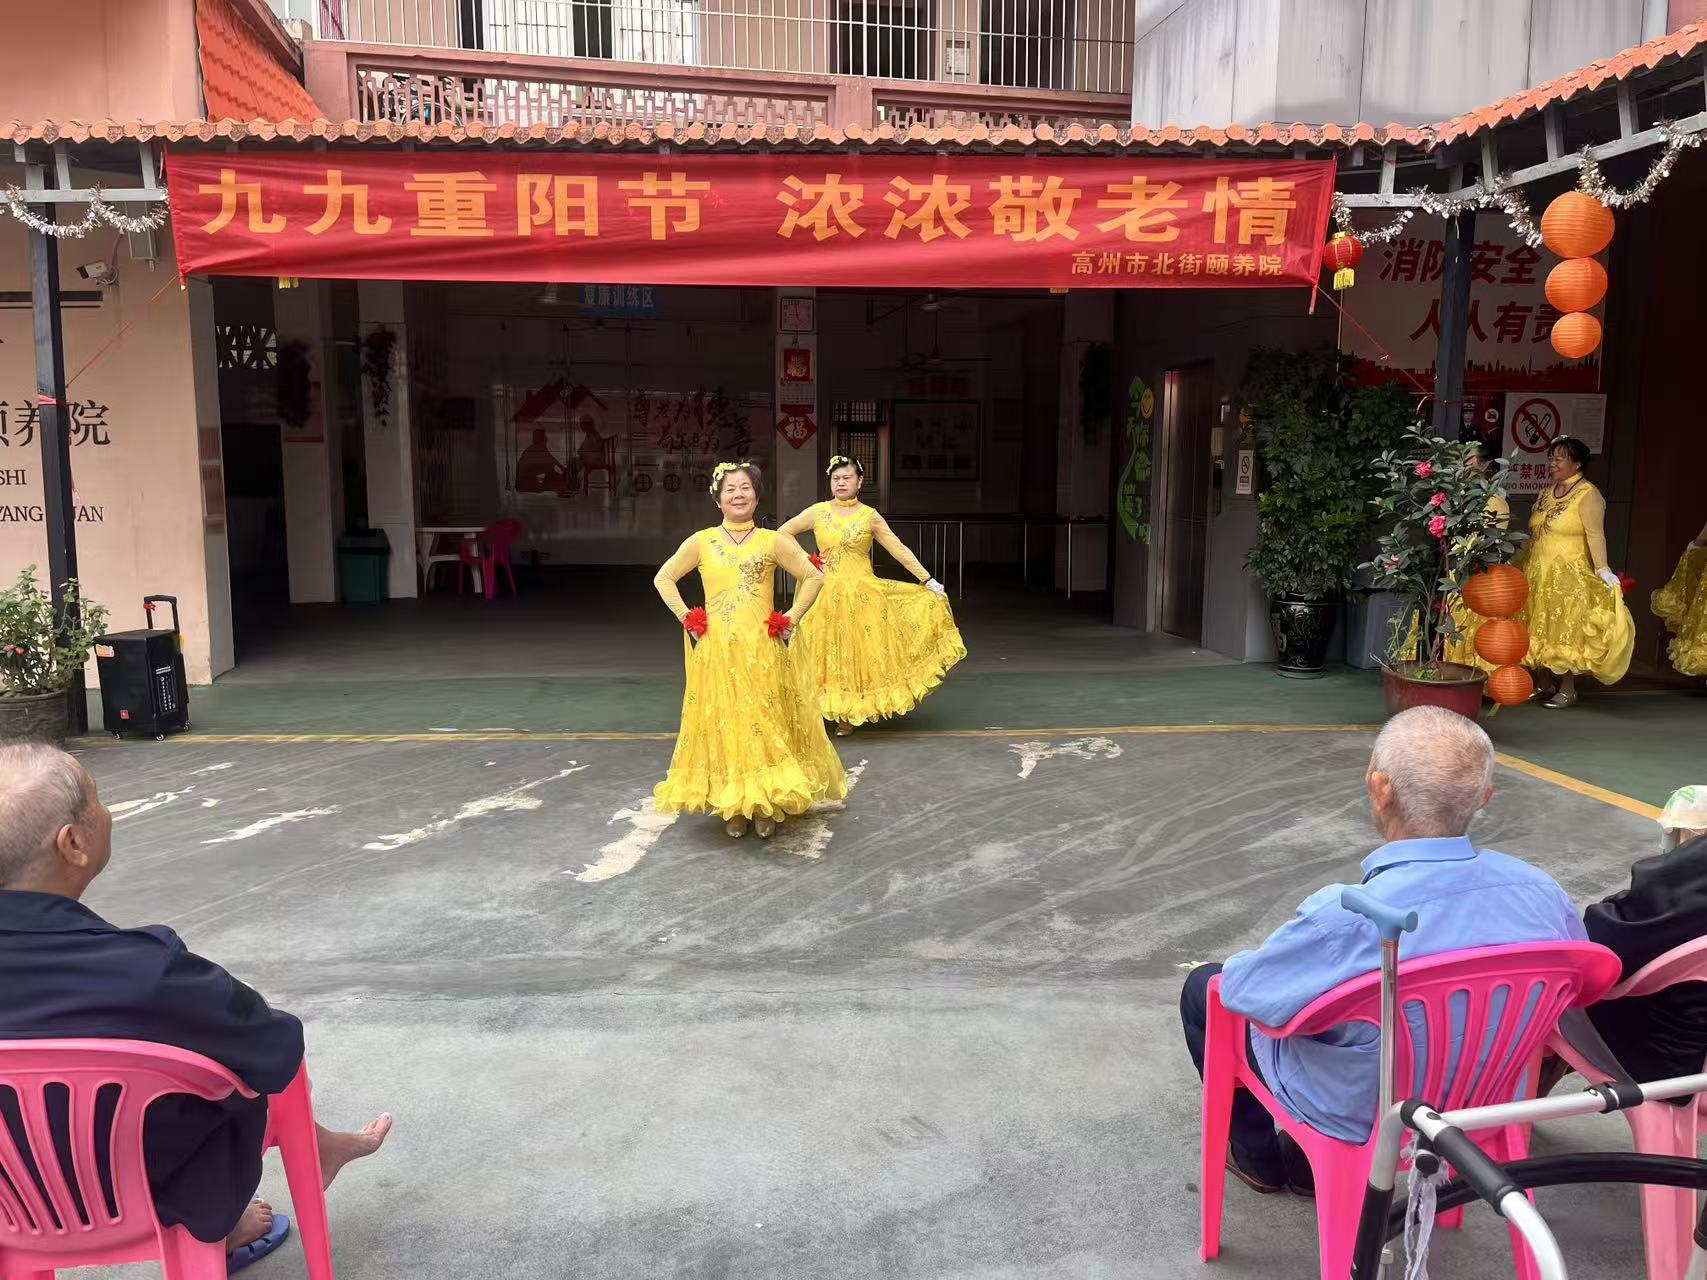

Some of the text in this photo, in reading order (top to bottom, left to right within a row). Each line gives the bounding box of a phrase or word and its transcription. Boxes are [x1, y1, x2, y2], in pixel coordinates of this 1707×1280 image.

[199, 169, 1297, 245] 九九重阳节 浓浓敬老情
[1071, 251, 1284, 276] 高州市北街颐养院
[784, 415, 808, 440] 福
